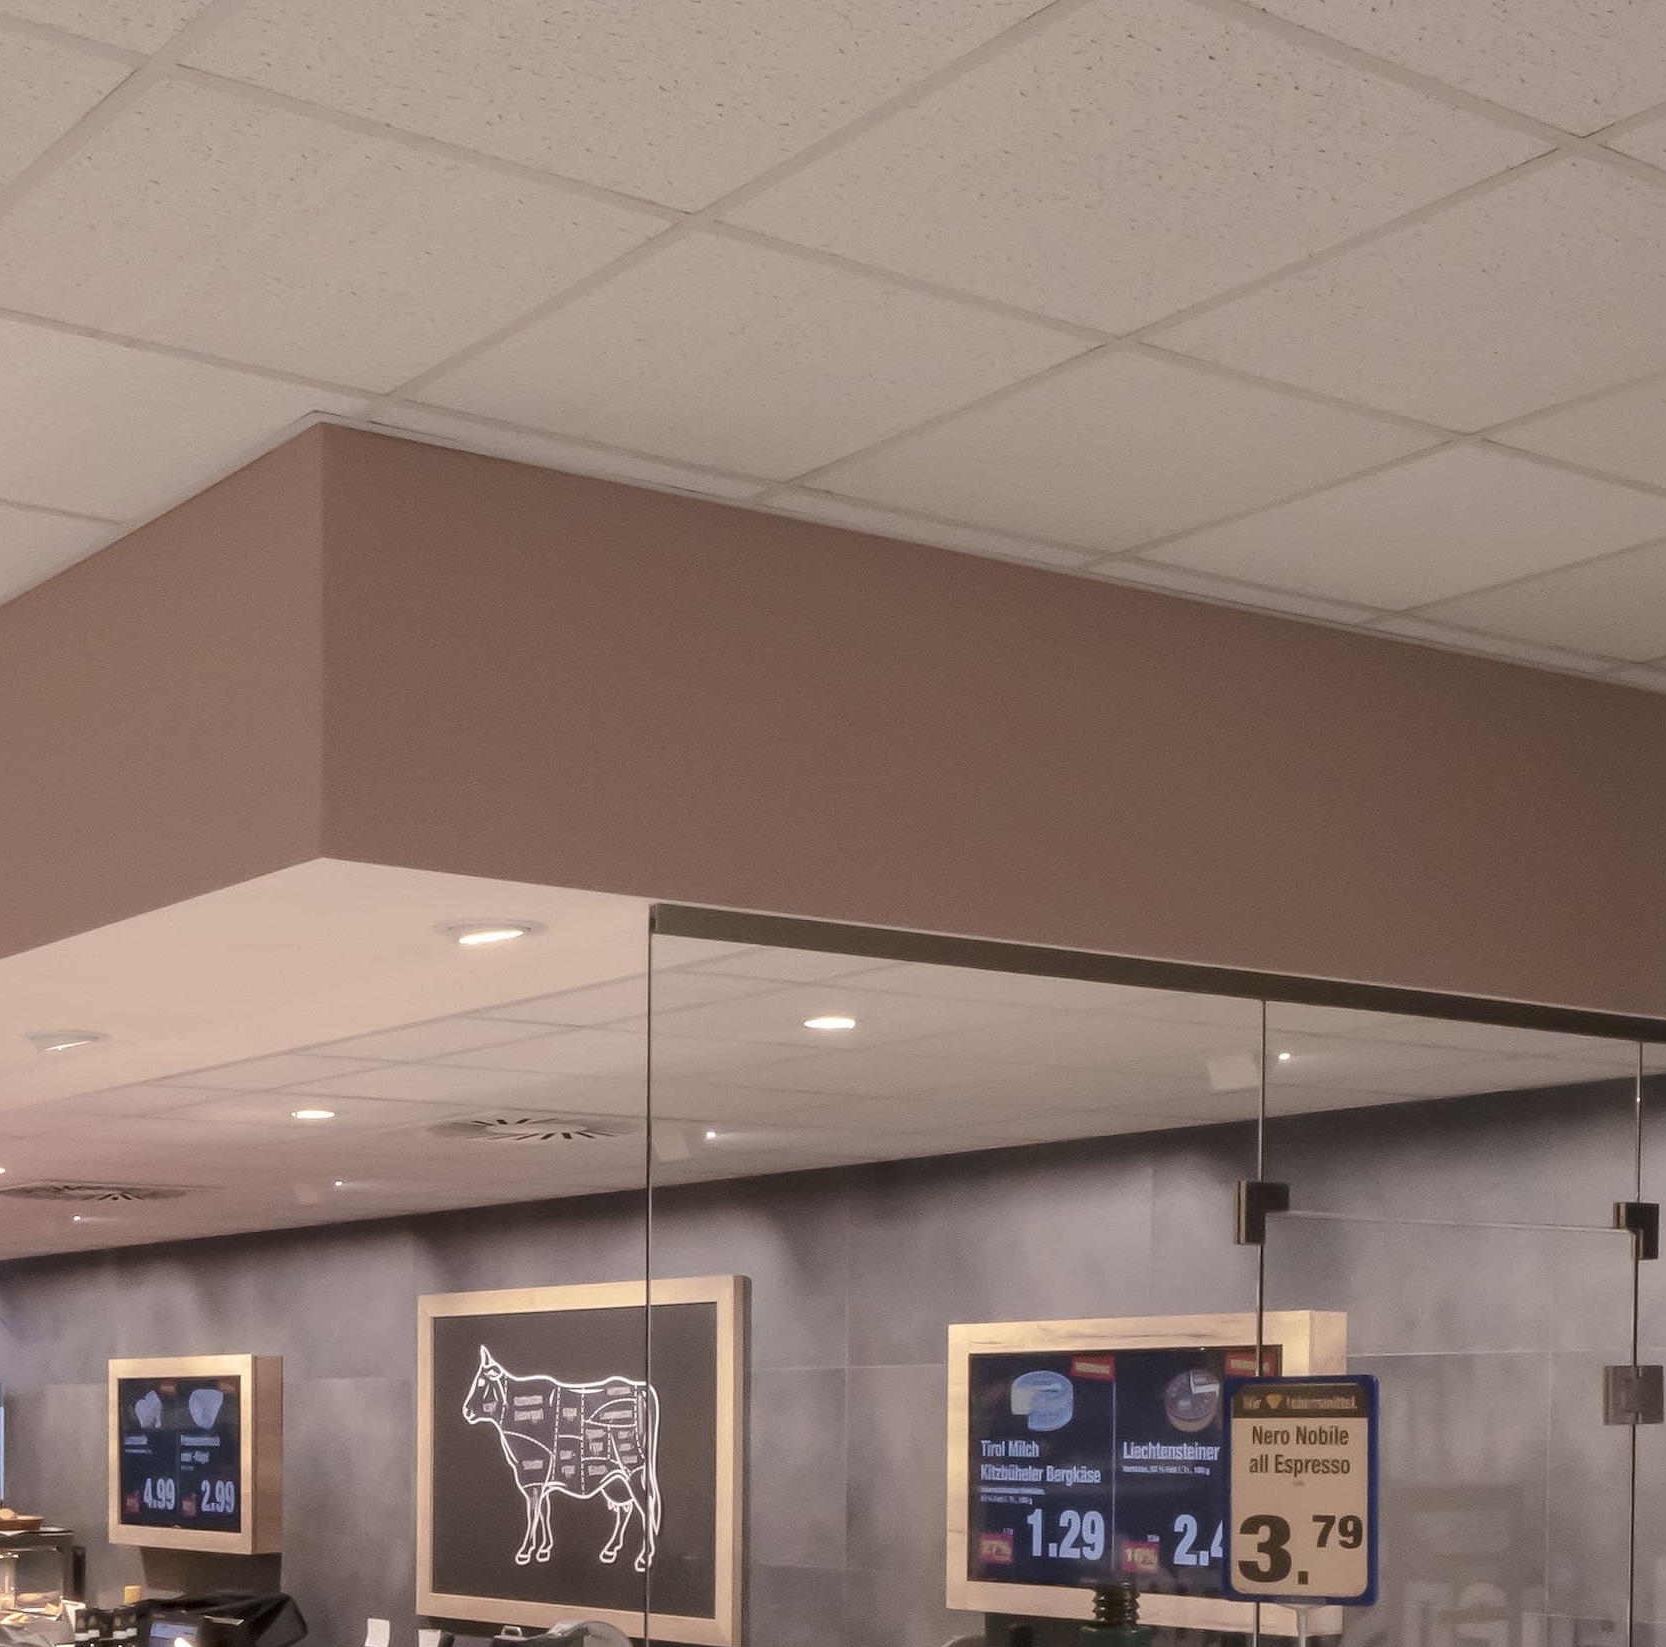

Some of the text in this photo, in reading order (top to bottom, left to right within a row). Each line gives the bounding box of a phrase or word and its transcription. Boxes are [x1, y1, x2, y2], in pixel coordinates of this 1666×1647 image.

[1252, 1425, 1349, 1446] Nero Nobile
[980, 1440, 1040, 1458] Tirol Milch
[1122, 1441, 1221, 1461] Liechtensteiner
[980, 1464, 1045, 1482] Kitzbüheler
[1046, 1465, 1102, 1486] Bergkäse
[1249, 1453, 1351, 1479] all Espresso
[144, 1477, 176, 1511] 4.99
[201, 1479, 236, 1514] 2.99
[1027, 1508, 1106, 1561] 1.29
